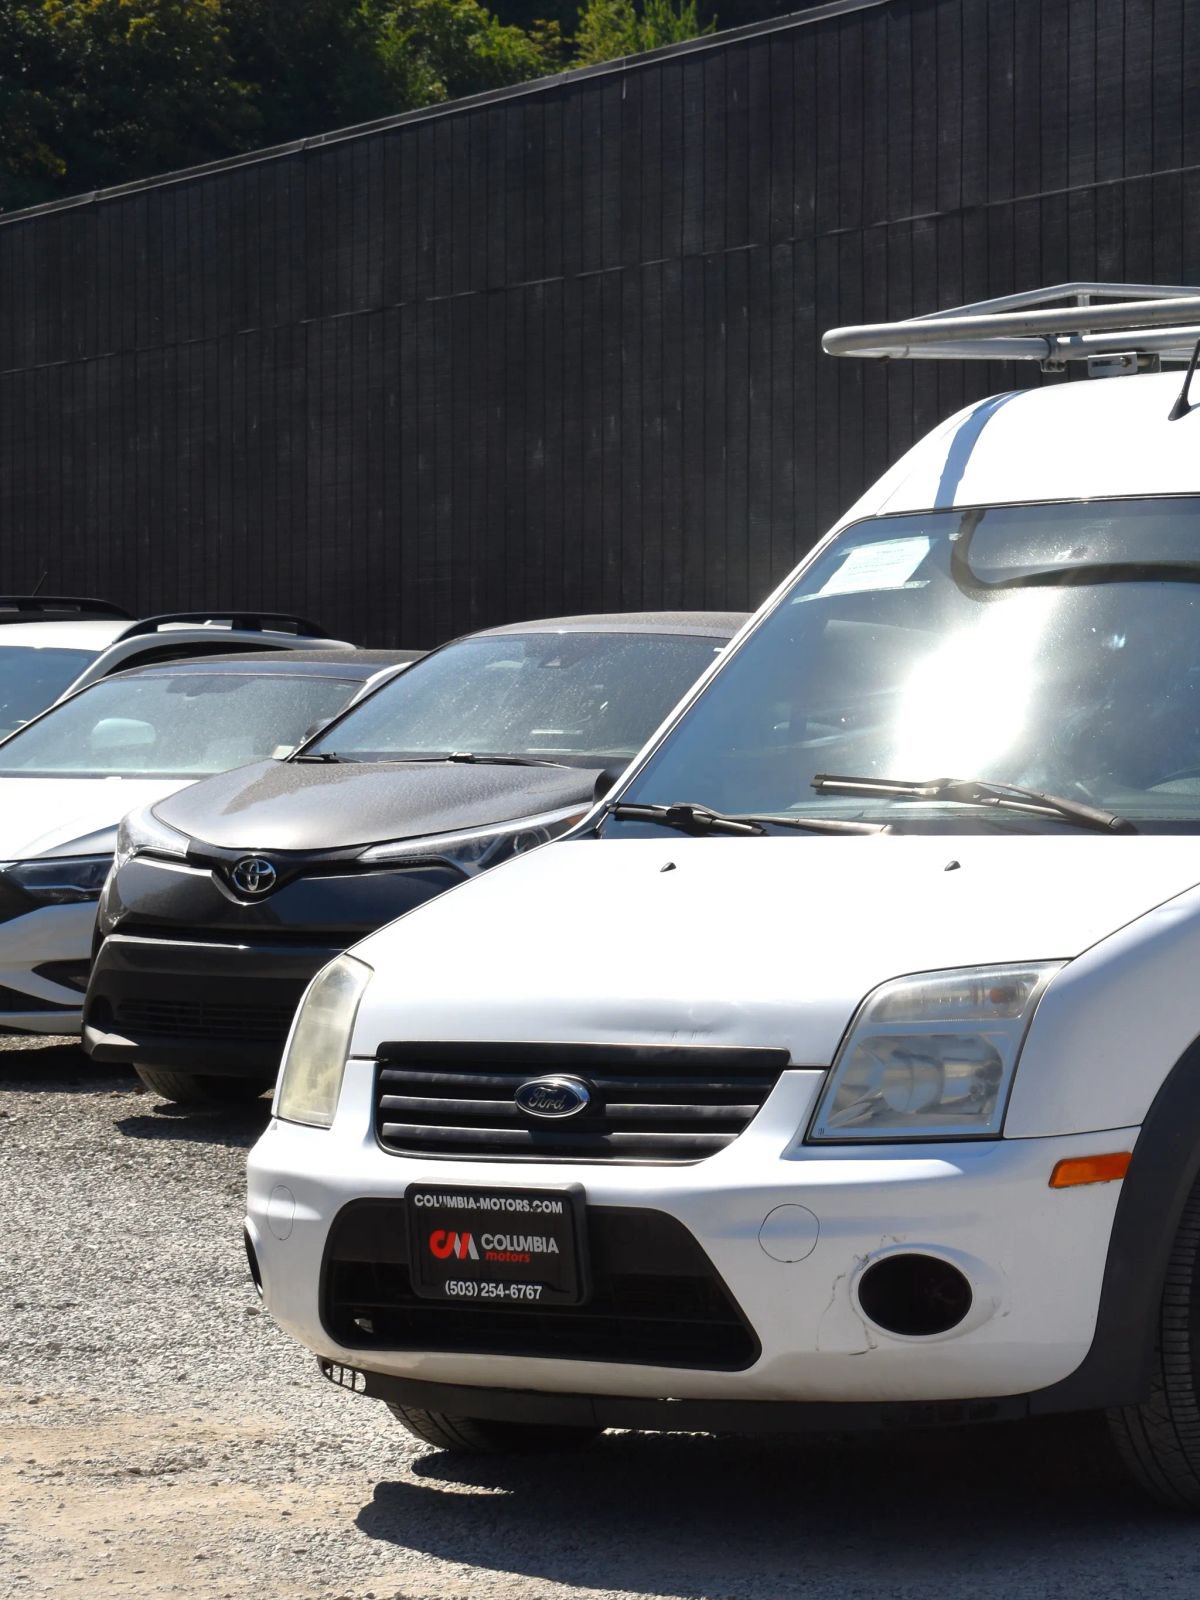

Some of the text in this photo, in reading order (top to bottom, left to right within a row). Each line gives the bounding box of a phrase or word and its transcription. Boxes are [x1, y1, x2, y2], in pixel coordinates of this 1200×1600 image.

[528, 1086, 567, 1110] Ford
[414, 1194, 563, 1214] COLUMBIA-MOTORS.COM
[481, 1233, 560, 1254] COLUMBIA
[485, 1251, 531, 1263] motors
[445, 1280, 542, 1300] (503) 254-6767
